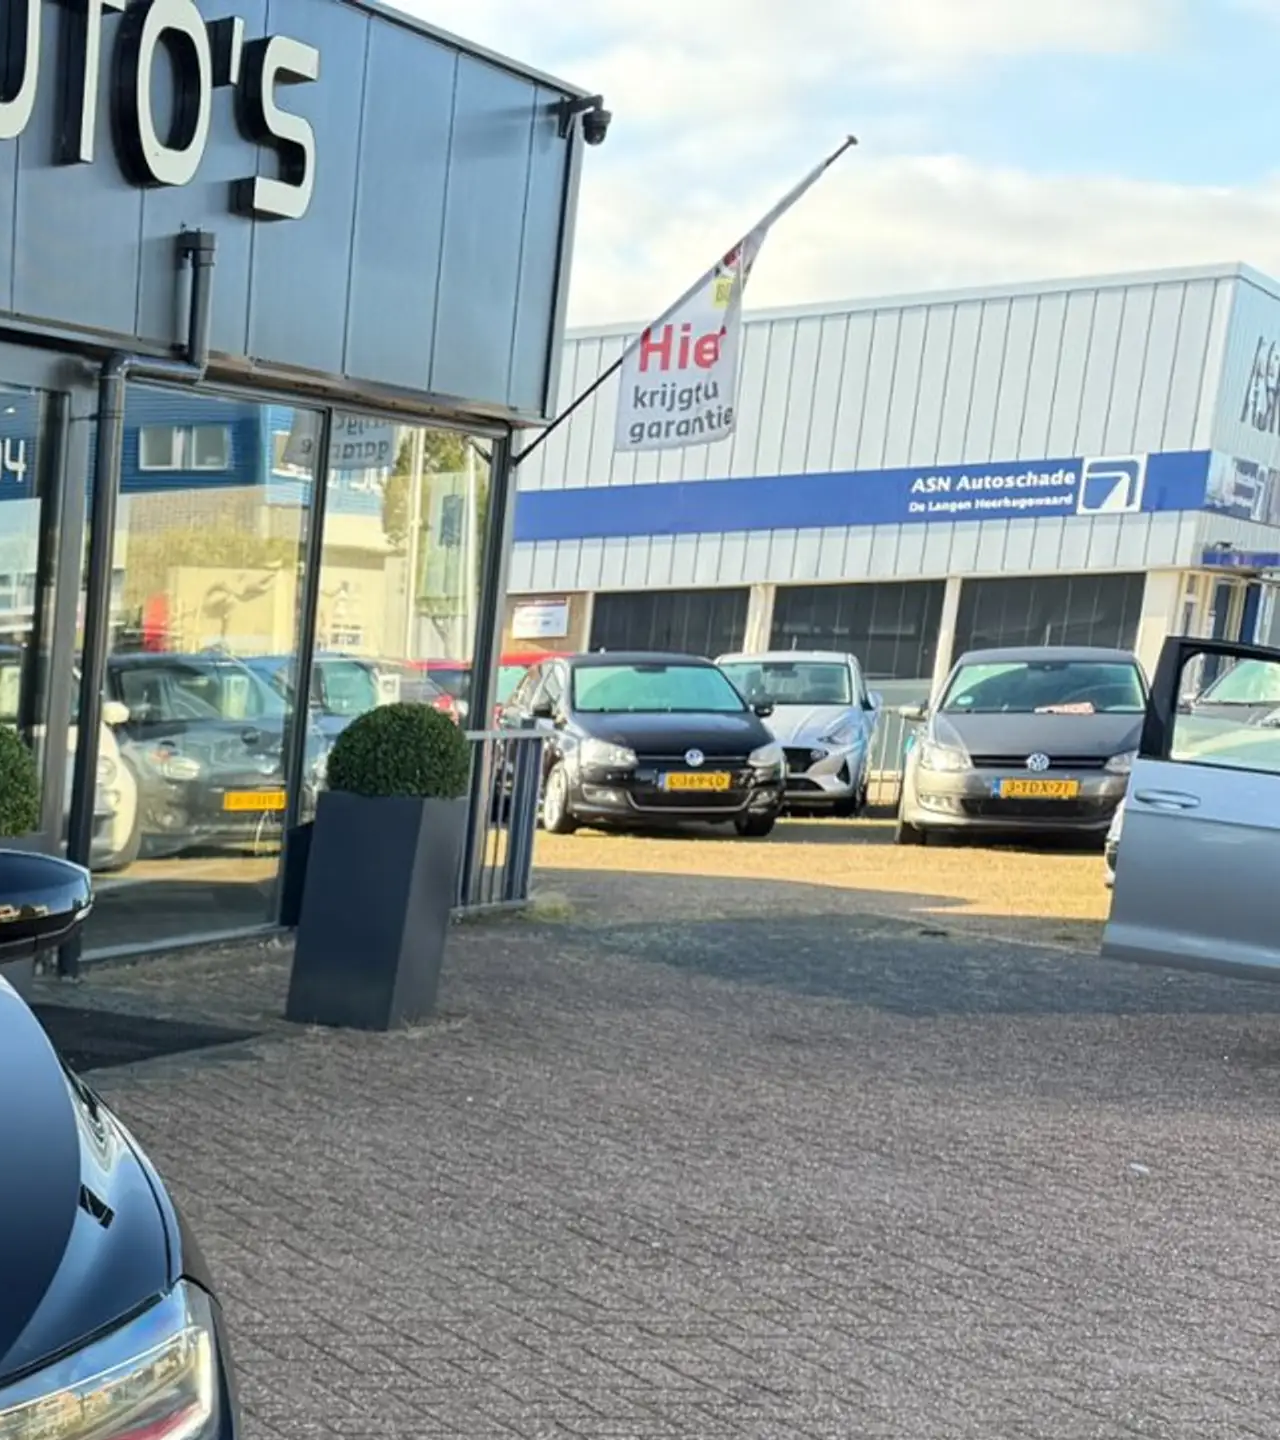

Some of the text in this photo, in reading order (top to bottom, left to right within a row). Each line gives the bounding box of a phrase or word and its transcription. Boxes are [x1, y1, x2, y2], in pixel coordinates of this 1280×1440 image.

[629, 405, 734, 445] garantie
[911, 468, 1076, 494] ASN Autoschade
[908, 501, 926, 513] De
